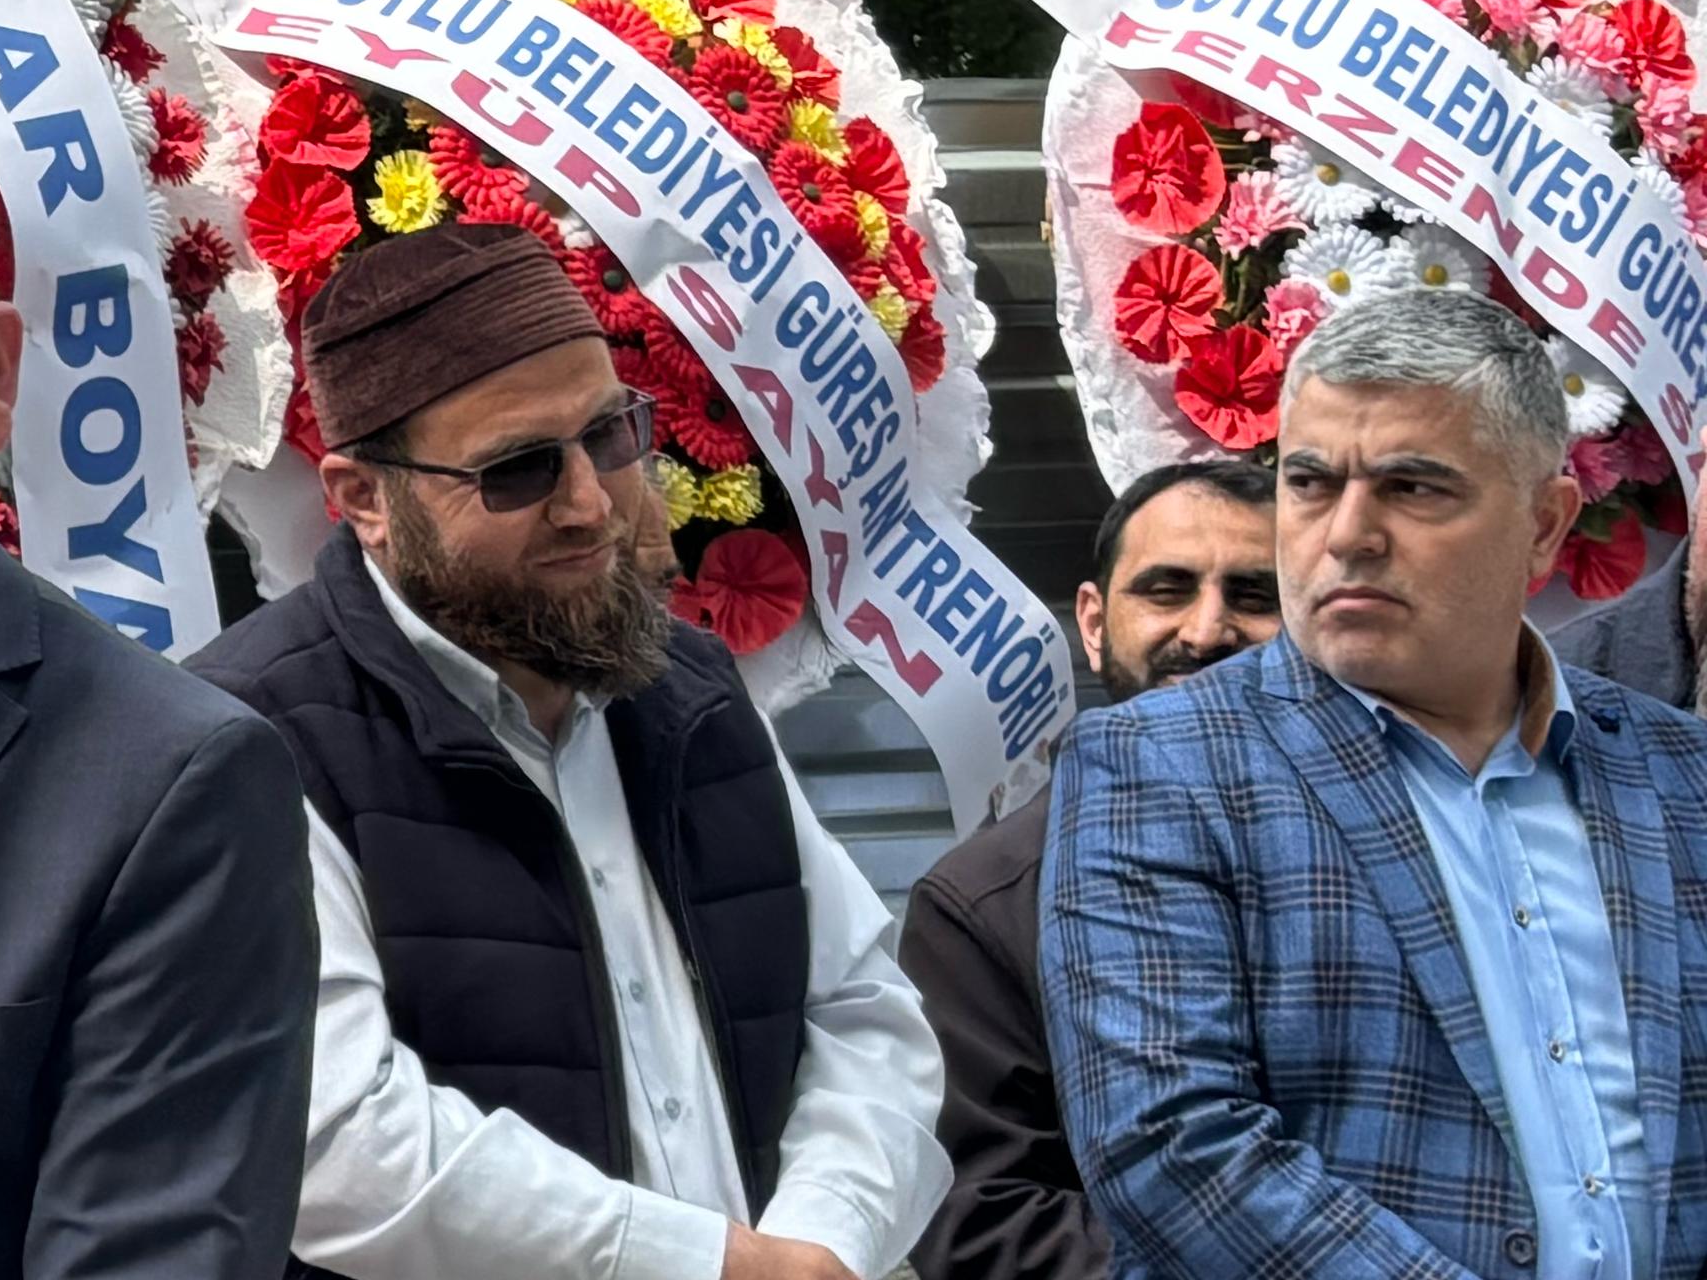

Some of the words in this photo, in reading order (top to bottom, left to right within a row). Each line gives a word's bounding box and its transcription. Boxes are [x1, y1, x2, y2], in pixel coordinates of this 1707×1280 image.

[236, 7, 642, 217] EYÜP
[665, 265, 944, 698] SAYAN
[496, 15, 803, 304] BELEDİYESİ
[775, 280, 901, 490] GÜREŞ
[858, 457, 1069, 762] ANTRENÖRÜ
[1104, 11, 1647, 368] FERZENDE
[1339, 8, 1637, 258] BELEDİYESİ
